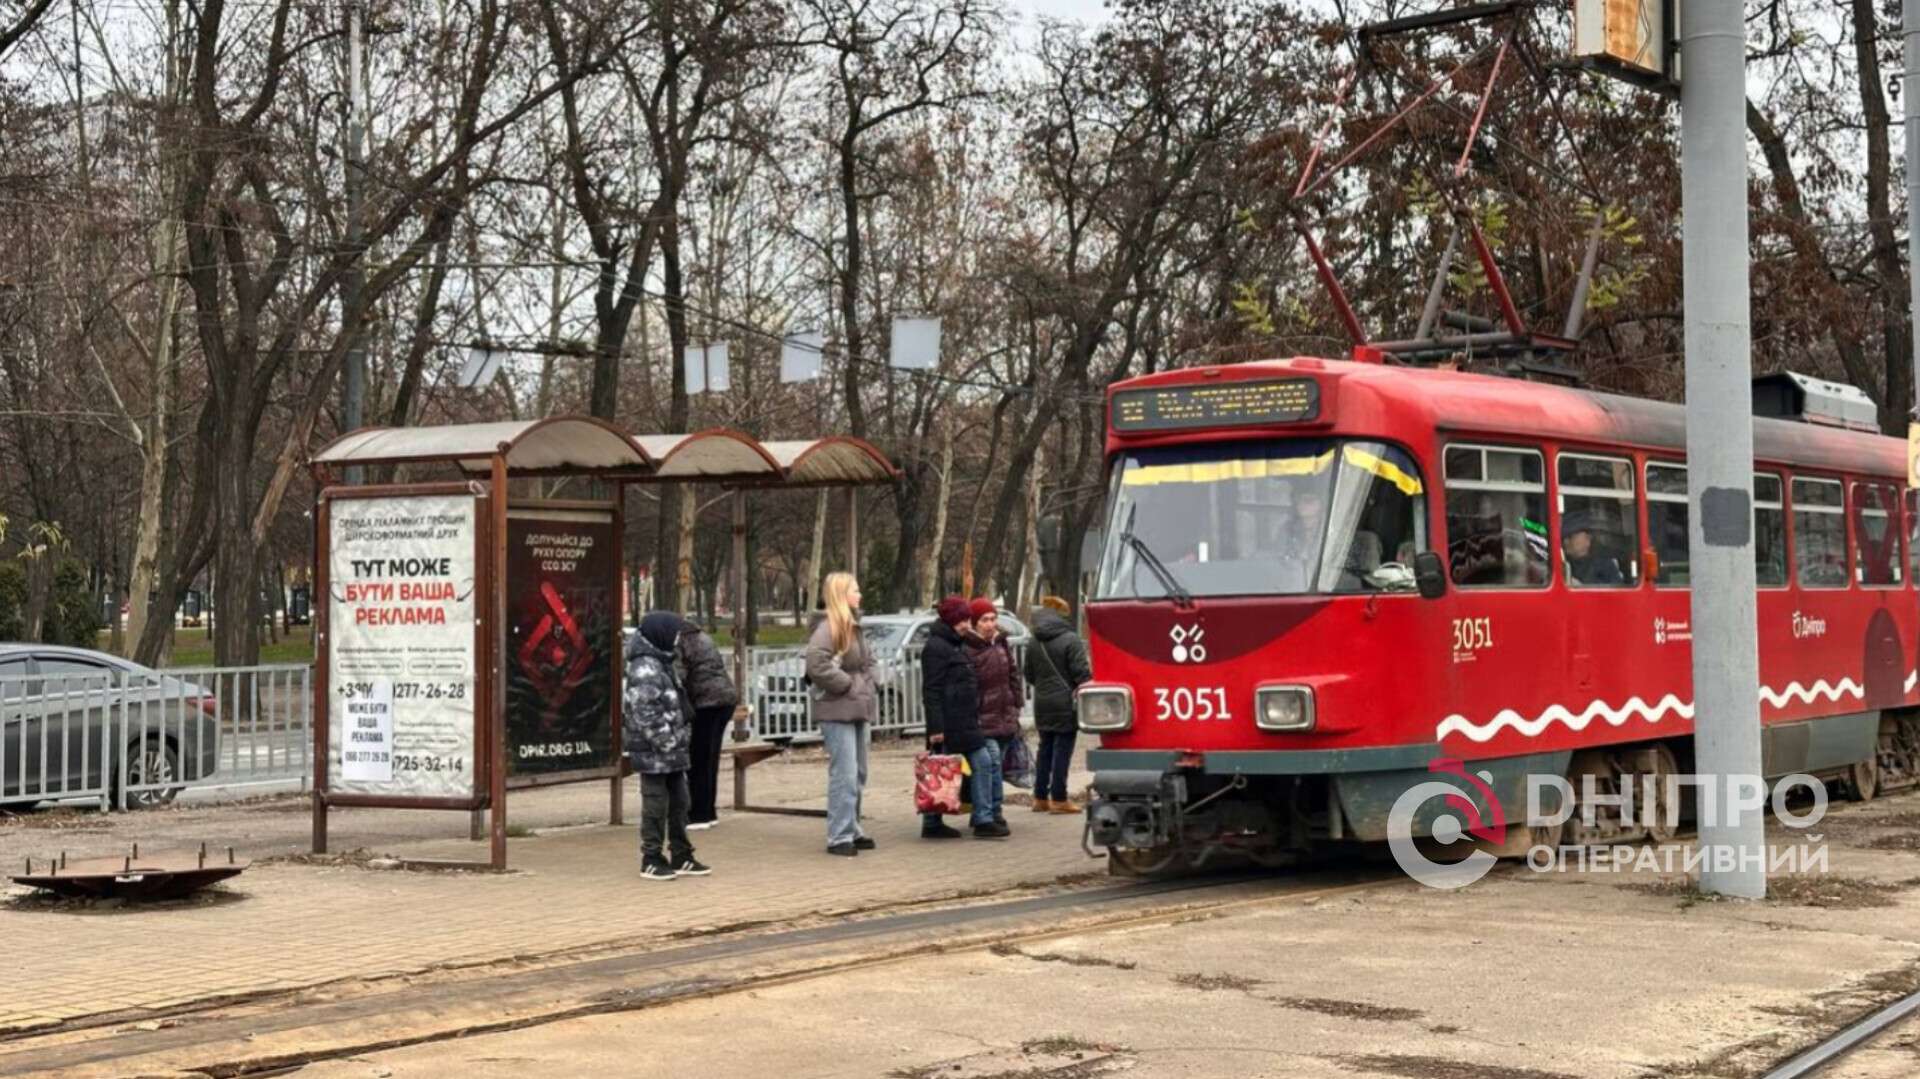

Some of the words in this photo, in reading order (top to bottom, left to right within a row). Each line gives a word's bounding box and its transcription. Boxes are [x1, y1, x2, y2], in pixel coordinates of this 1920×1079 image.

[436, 529, 459, 539] ДРУК
[580, 536, 594, 547] ДО
[532, 547, 555, 558] РУХУ
[555, 548, 587, 559] ОПОРУ
[351, 560, 385, 577] ТУТ
[390, 558, 451, 576] МОЖЕ
[346, 583, 393, 602] БУТИ
[400, 582, 455, 601] ВАША
[355, 607, 446, 625] РЕКЛАМА
[1452, 616, 1493, 650] 3051
[348, 703, 368, 714] МОЖЕ
[369, 703, 388, 714] БУТИ
[1153, 687, 1232, 722] 3051
[357, 717, 378, 729] ВАША
[351, 731, 384, 743] РЕКЛАМА
